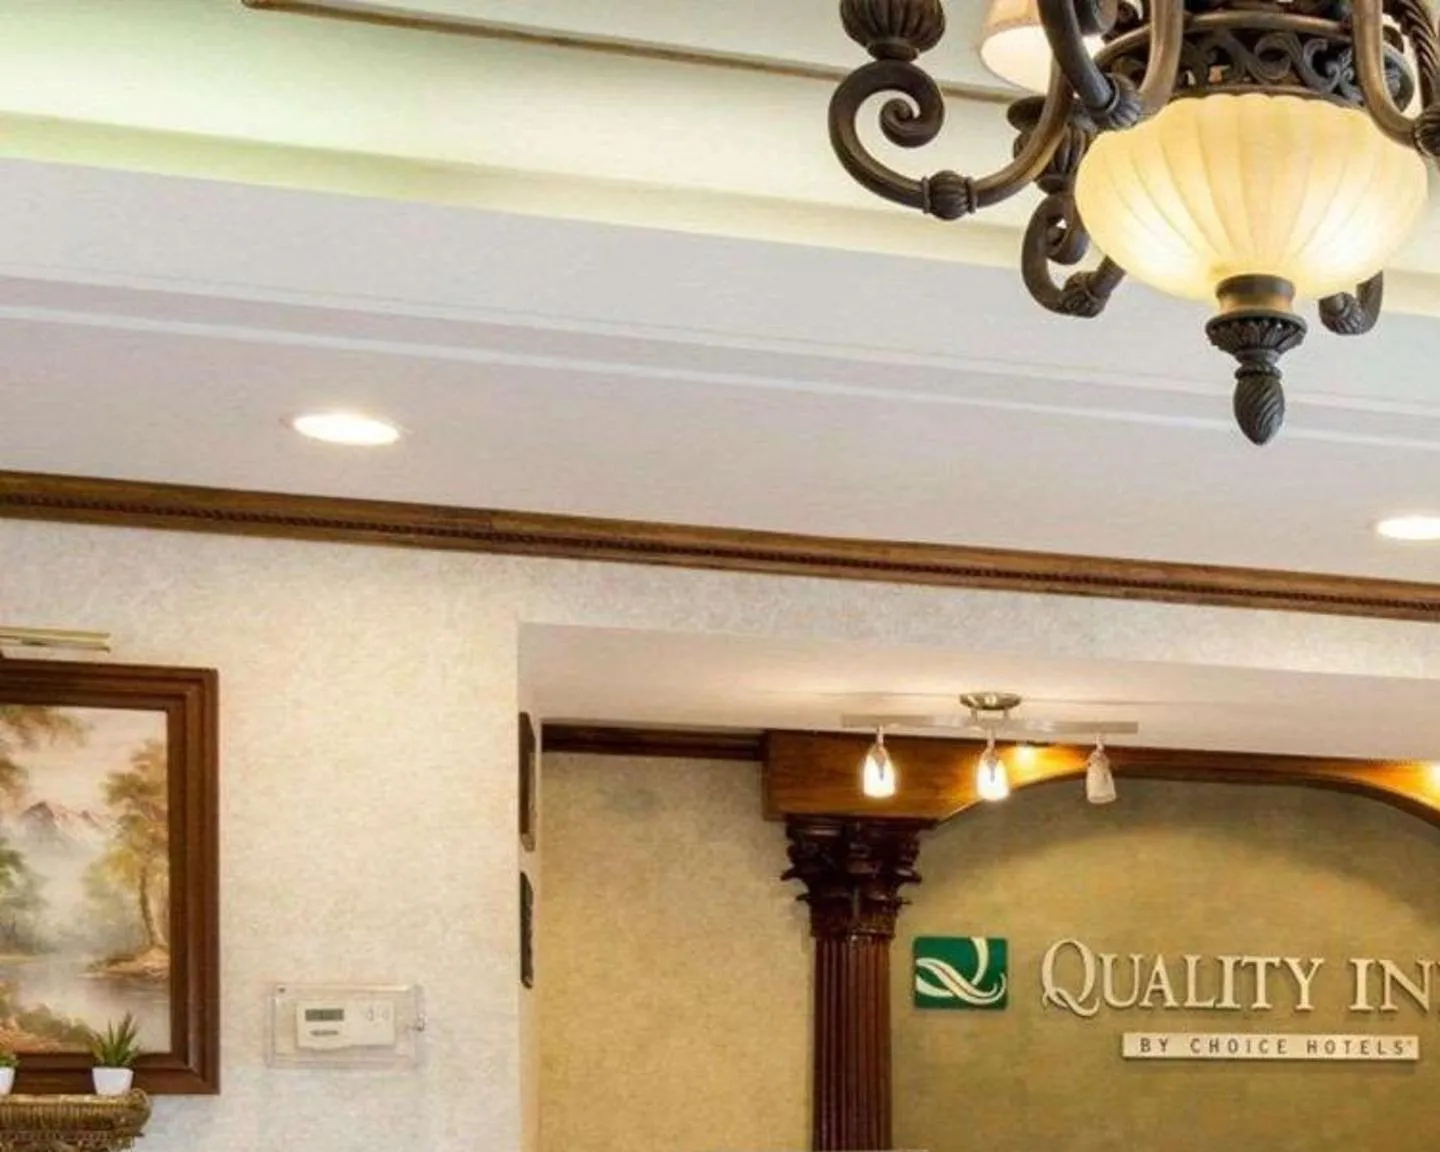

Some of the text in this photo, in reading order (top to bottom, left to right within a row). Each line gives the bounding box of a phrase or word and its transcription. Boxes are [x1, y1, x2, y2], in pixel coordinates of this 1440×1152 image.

[1041, 939, 1325, 1017] QUALITY
[1140, 1037, 1406, 1056] BY CHOICE HOTELS
